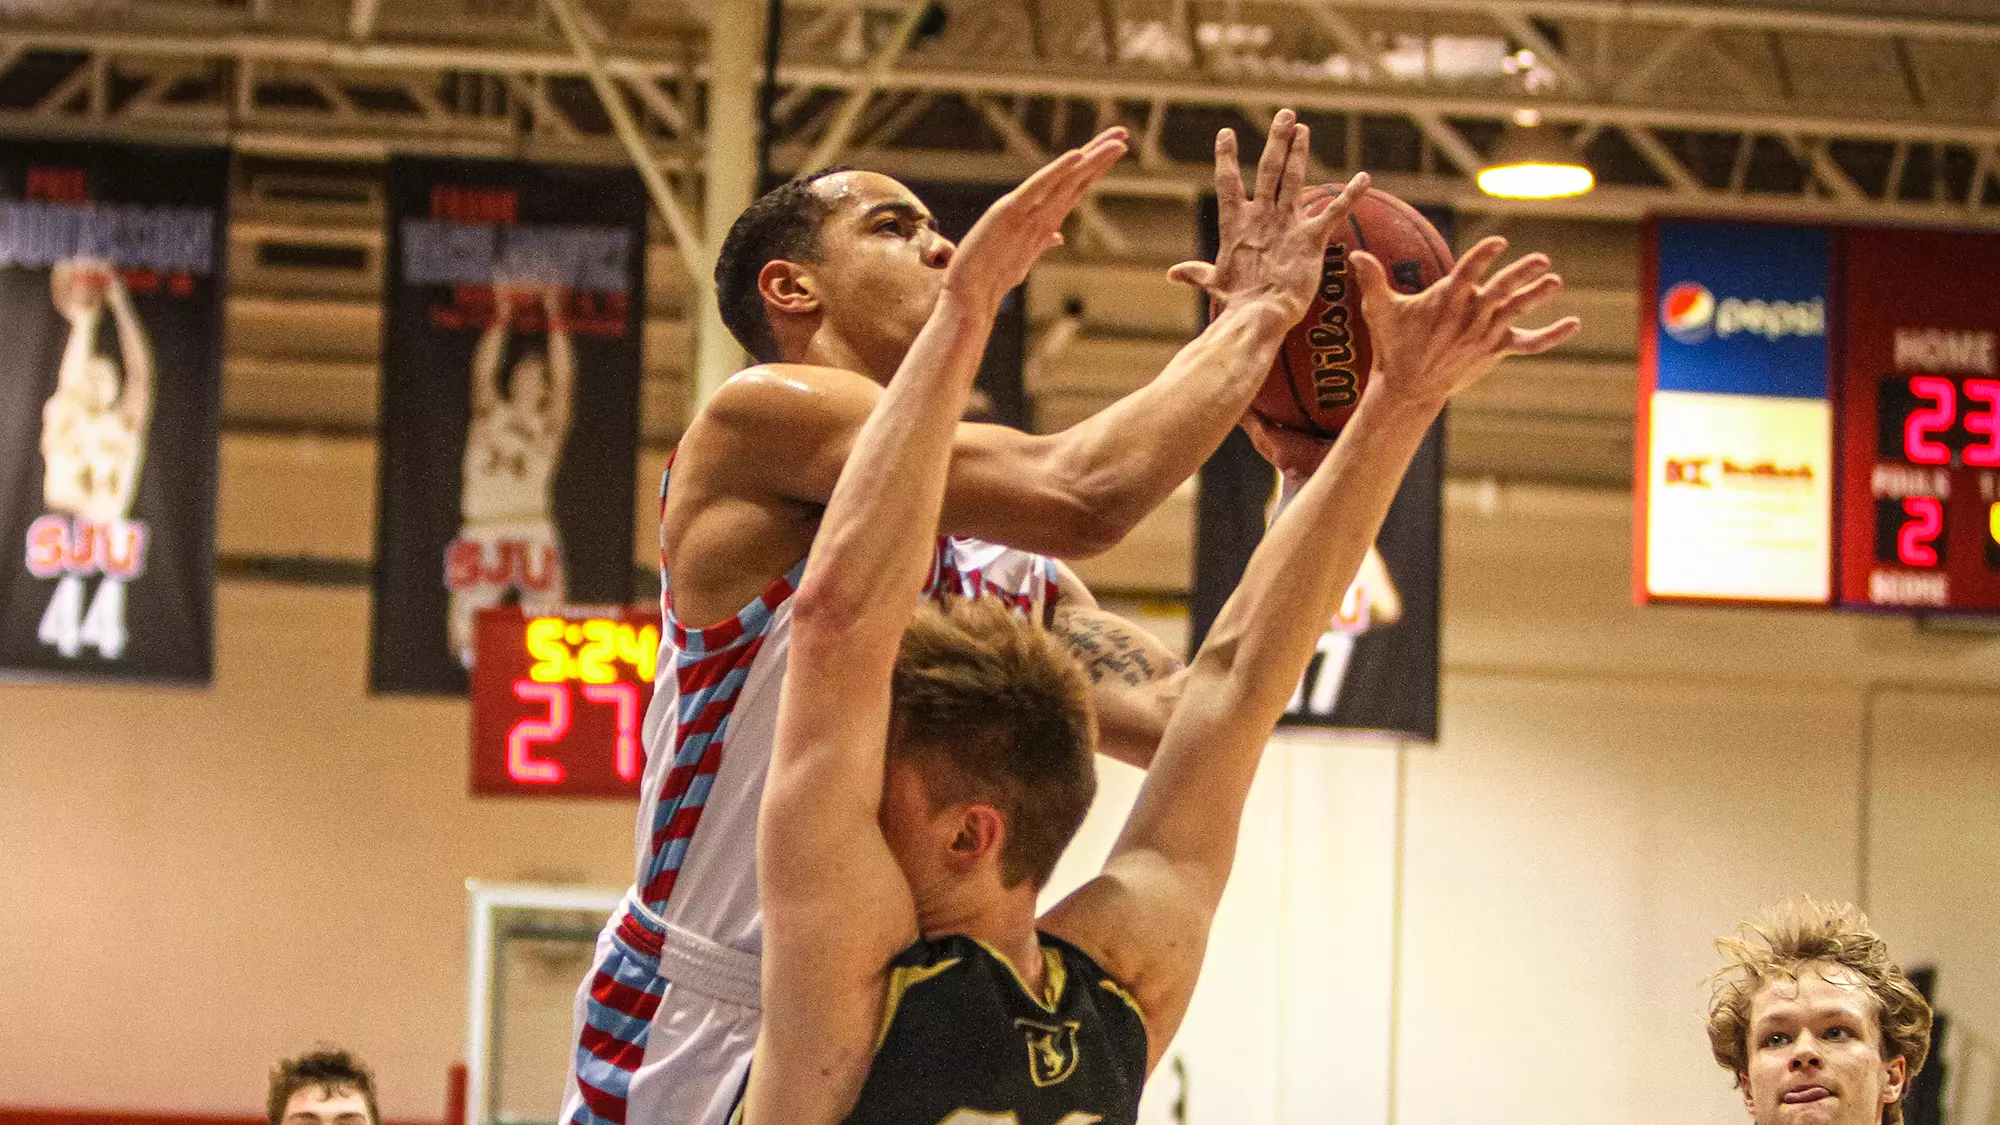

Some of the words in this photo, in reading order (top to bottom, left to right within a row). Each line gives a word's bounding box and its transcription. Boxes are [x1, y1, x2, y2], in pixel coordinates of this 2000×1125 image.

[1309, 243, 1361, 409] Wilson
[1716, 297, 1825, 342] pepsi
[1903, 376, 2000, 468] 23
[27, 516, 149, 577] SJU
[445, 539, 561, 591] SJU
[1897, 496, 1943, 567] 2
[37, 573, 127, 659] 44
[526, 617, 660, 682] 5:24
[508, 678, 640, 783] 27
